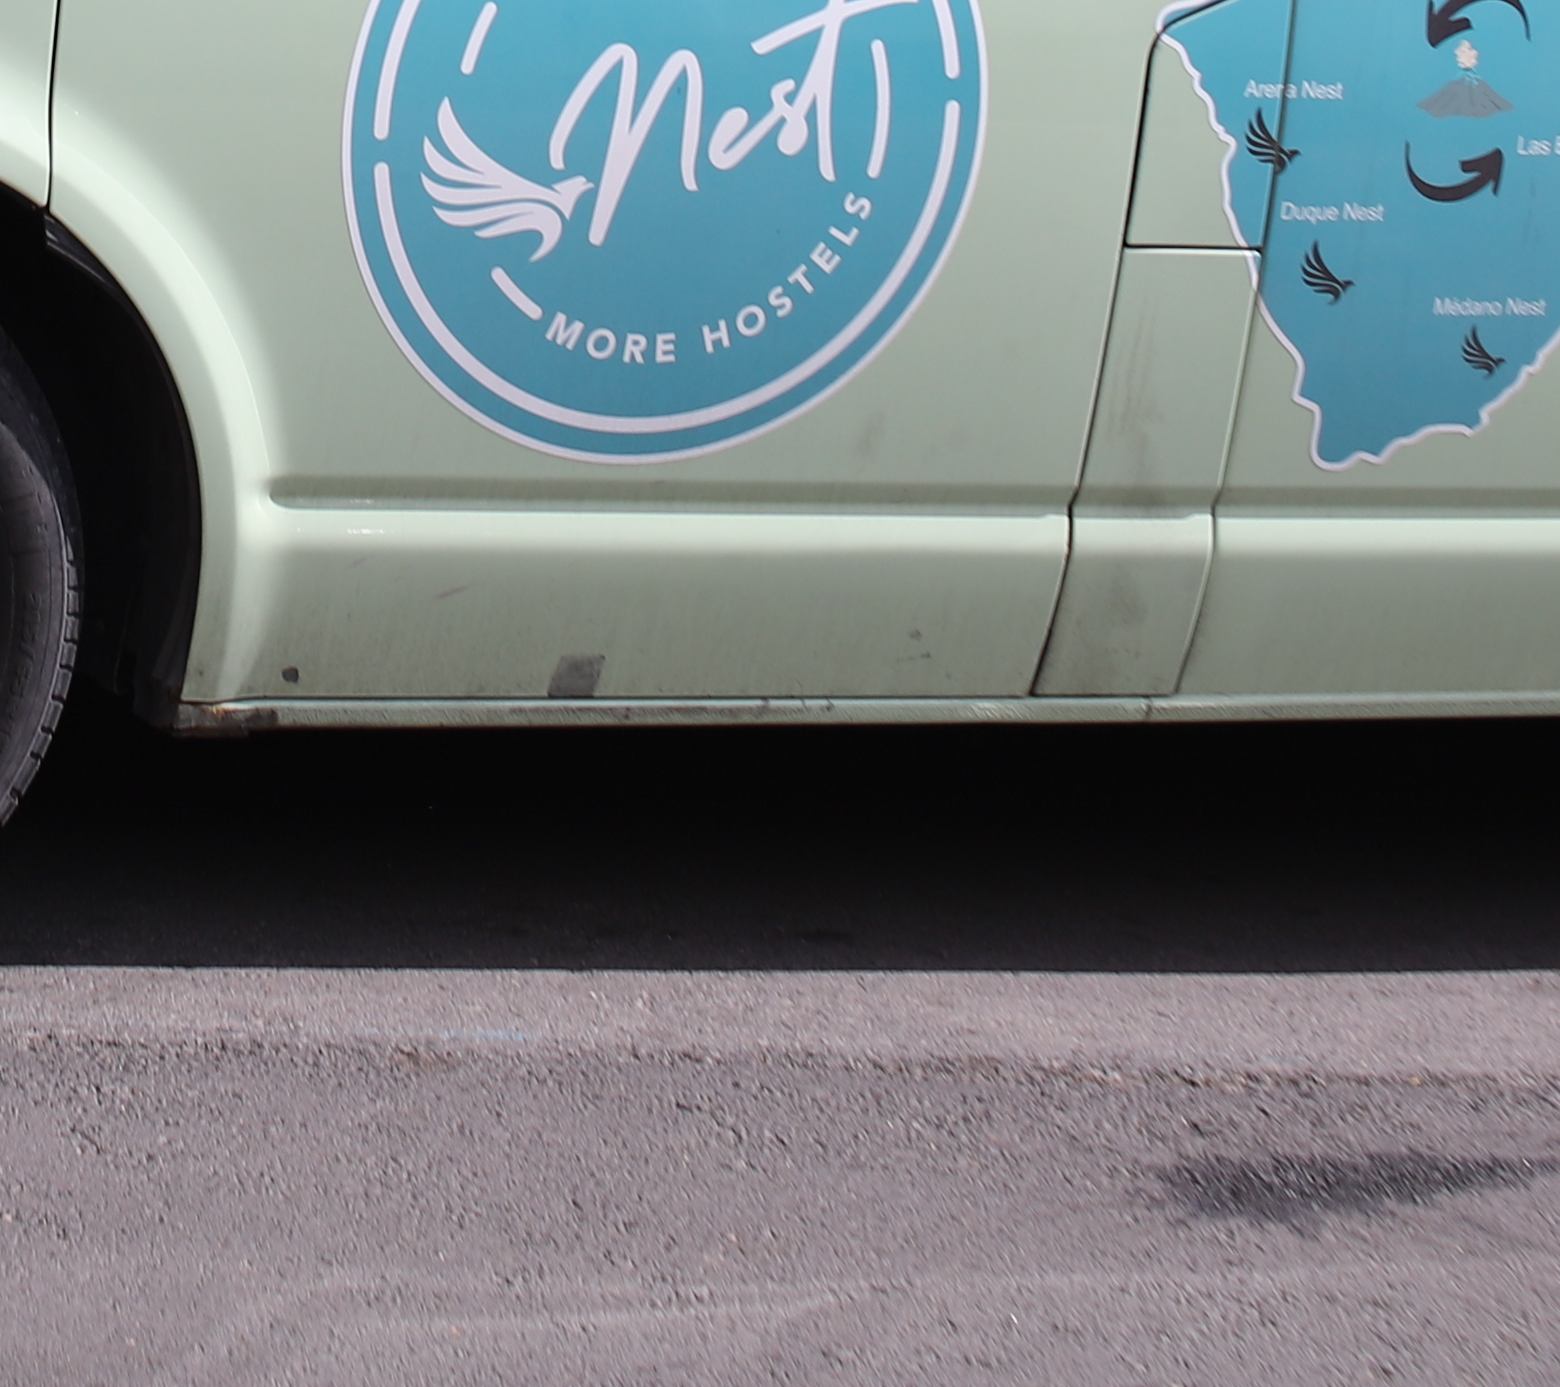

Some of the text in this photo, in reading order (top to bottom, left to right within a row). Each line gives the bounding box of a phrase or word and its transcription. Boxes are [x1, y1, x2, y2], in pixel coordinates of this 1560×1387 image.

[1301, 80, 1344, 100] Nest
[1516, 134, 1552, 156] Las
[1280, 201, 1384, 225] Duque Nest
[544, 191, 874, 365] MORE HOSTELS
[1505, 297, 1547, 317] Nest
